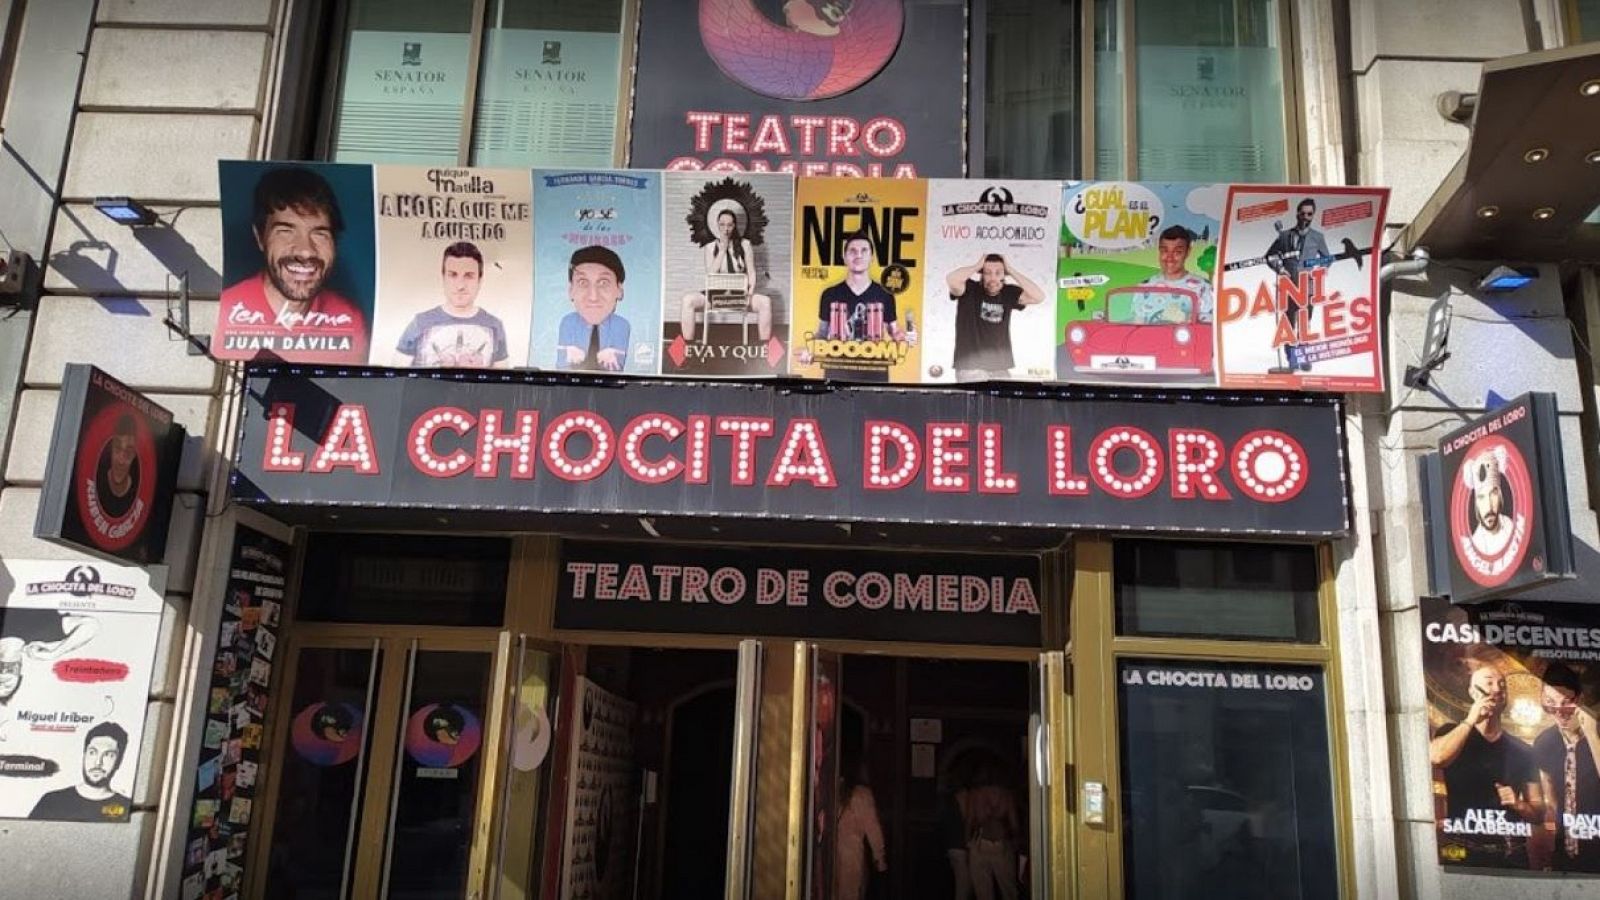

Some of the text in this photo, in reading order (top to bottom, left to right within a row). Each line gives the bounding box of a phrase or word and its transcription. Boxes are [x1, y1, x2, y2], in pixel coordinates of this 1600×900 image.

[374, 69, 446, 83] SENATOR
[514, 68, 587, 83] SENATOR
[684, 111, 908, 157] TEATRO
[380, 194, 529, 221] AHORA QUE ME
[942, 206, 955, 216] LA
[802, 205, 919, 267] NENE
[941, 225, 970, 239] VIVO
[1083, 211, 1160, 240] PLAN?
[1219, 266, 1328, 323] DANI
[228, 300, 352, 331] ten karma
[1272, 291, 1372, 348] ALÉS
[225, 333, 350, 350] JUAN DÁVILA
[685, 345, 714, 363] EVA
[719, 345, 730, 358] Y
[263, 401, 1309, 503] LA CHOCITA DEL LORO
[1443, 443, 1453, 456] LA
[1453, 424, 1489, 450] CHOCITA
[26, 582, 135, 598] LA CHOCITA DEL LORO
[567, 562, 1041, 615] TEATRO DE COMEDIA
[1426, 622, 1600, 649] CASI DECENTES
[1122, 669, 1314, 691] LA CHOCITA DEL LORO
[17, 710, 58, 722] Miguel
[1443, 818, 1532, 837] SALABERRI
[1465, 808, 1507, 823] ALEX
